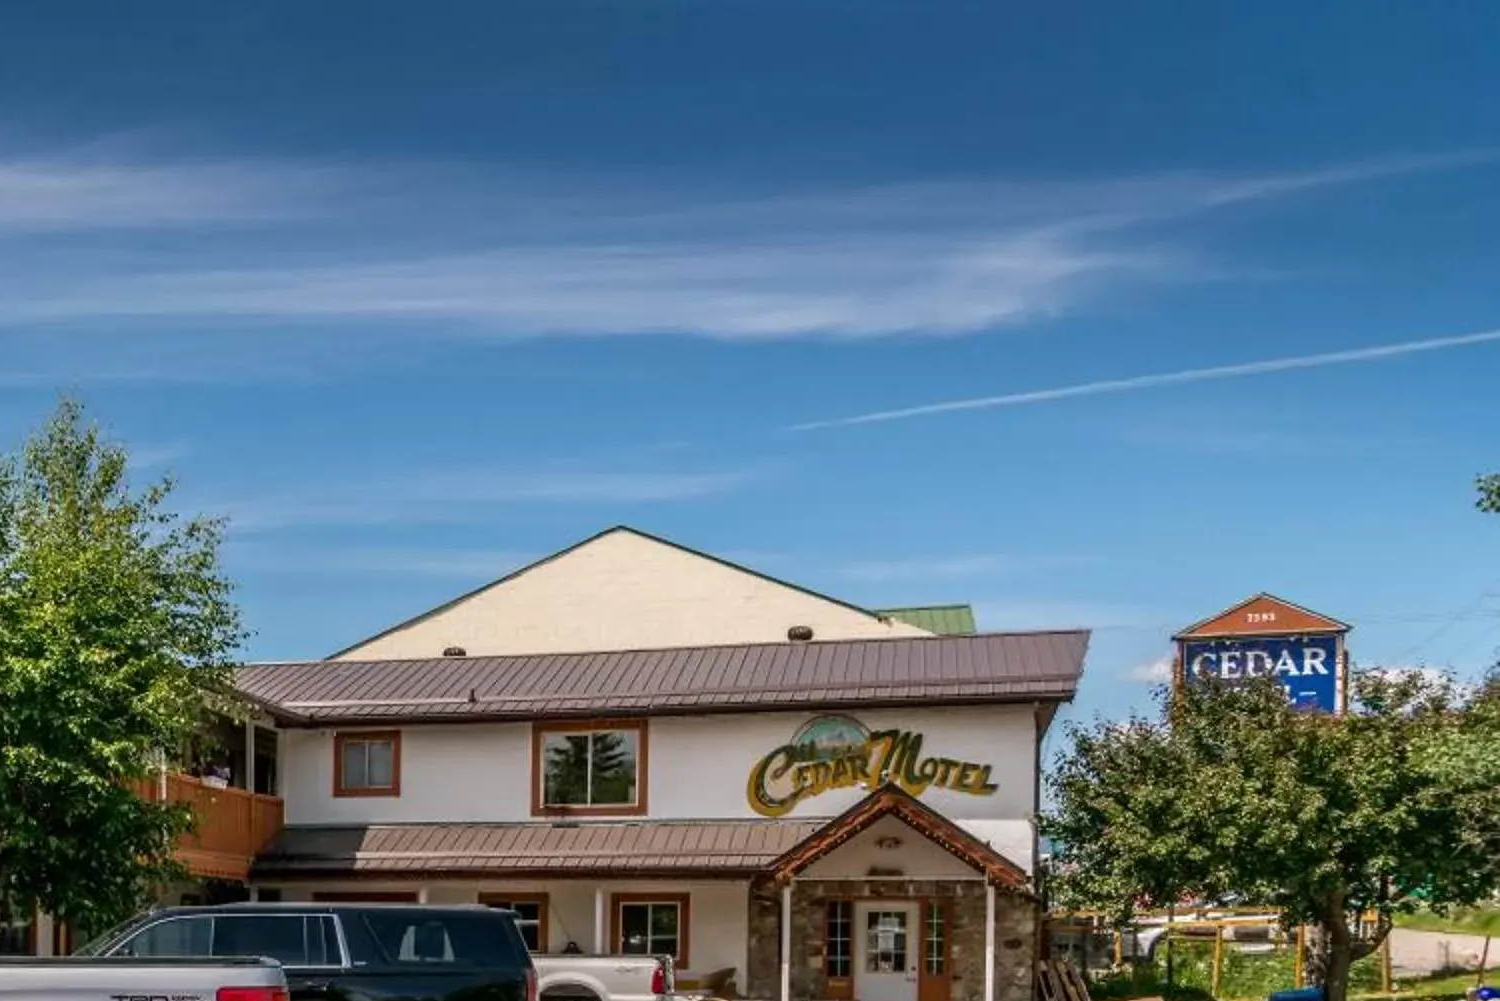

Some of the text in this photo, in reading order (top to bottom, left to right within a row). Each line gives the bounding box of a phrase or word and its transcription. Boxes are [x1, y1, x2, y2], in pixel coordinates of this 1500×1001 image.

[1191, 648, 1329, 679] CEDAR
[747, 729, 999, 816] CEDAR MOTEL
